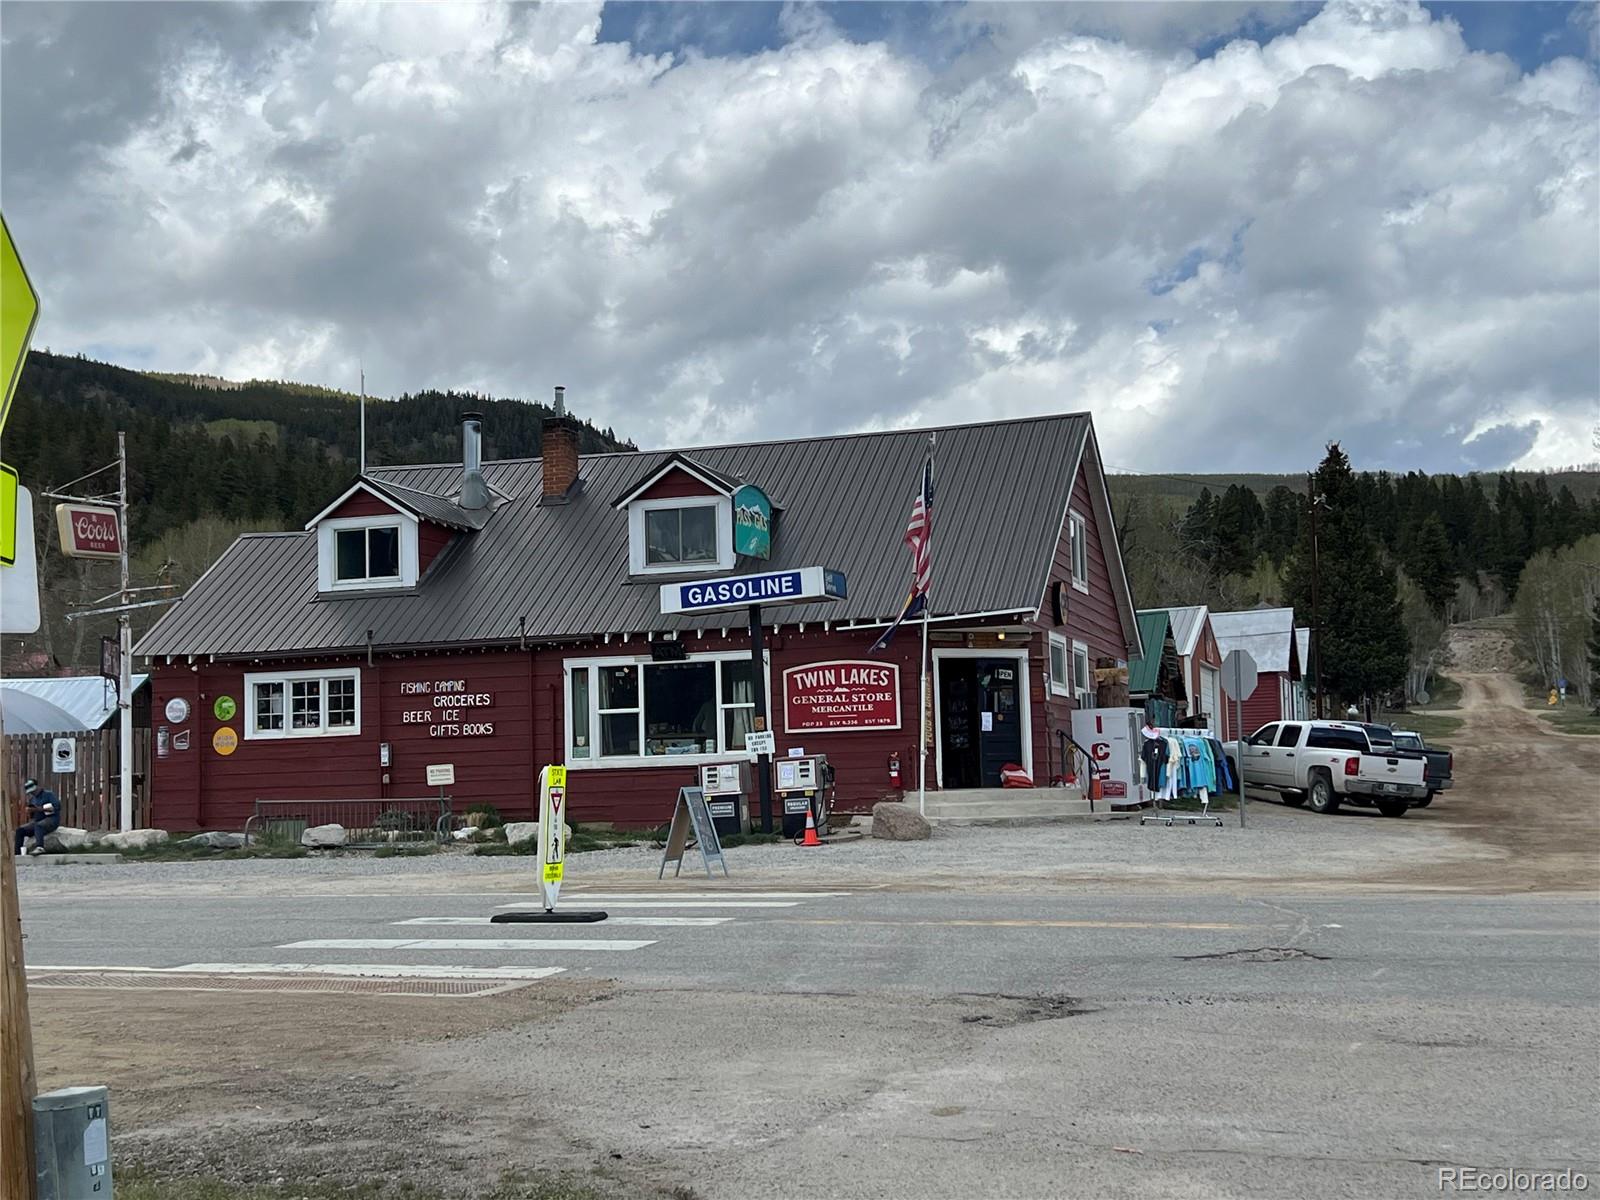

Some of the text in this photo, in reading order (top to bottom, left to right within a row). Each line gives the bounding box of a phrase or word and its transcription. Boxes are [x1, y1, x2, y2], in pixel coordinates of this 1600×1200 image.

[75, 517, 115, 541] Coors
[688, 576, 794, 604] GASOLINE
[793, 668, 890, 690] TWIN LAKES
[401, 680, 466, 694] FISHING CAMPING
[792, 692, 893, 705] GENERAL STORE
[811, 703, 874, 714] MERCANTILE
[402, 709, 460, 723] BEER ICE
[429, 723, 494, 737] GIFTS BOOKS
